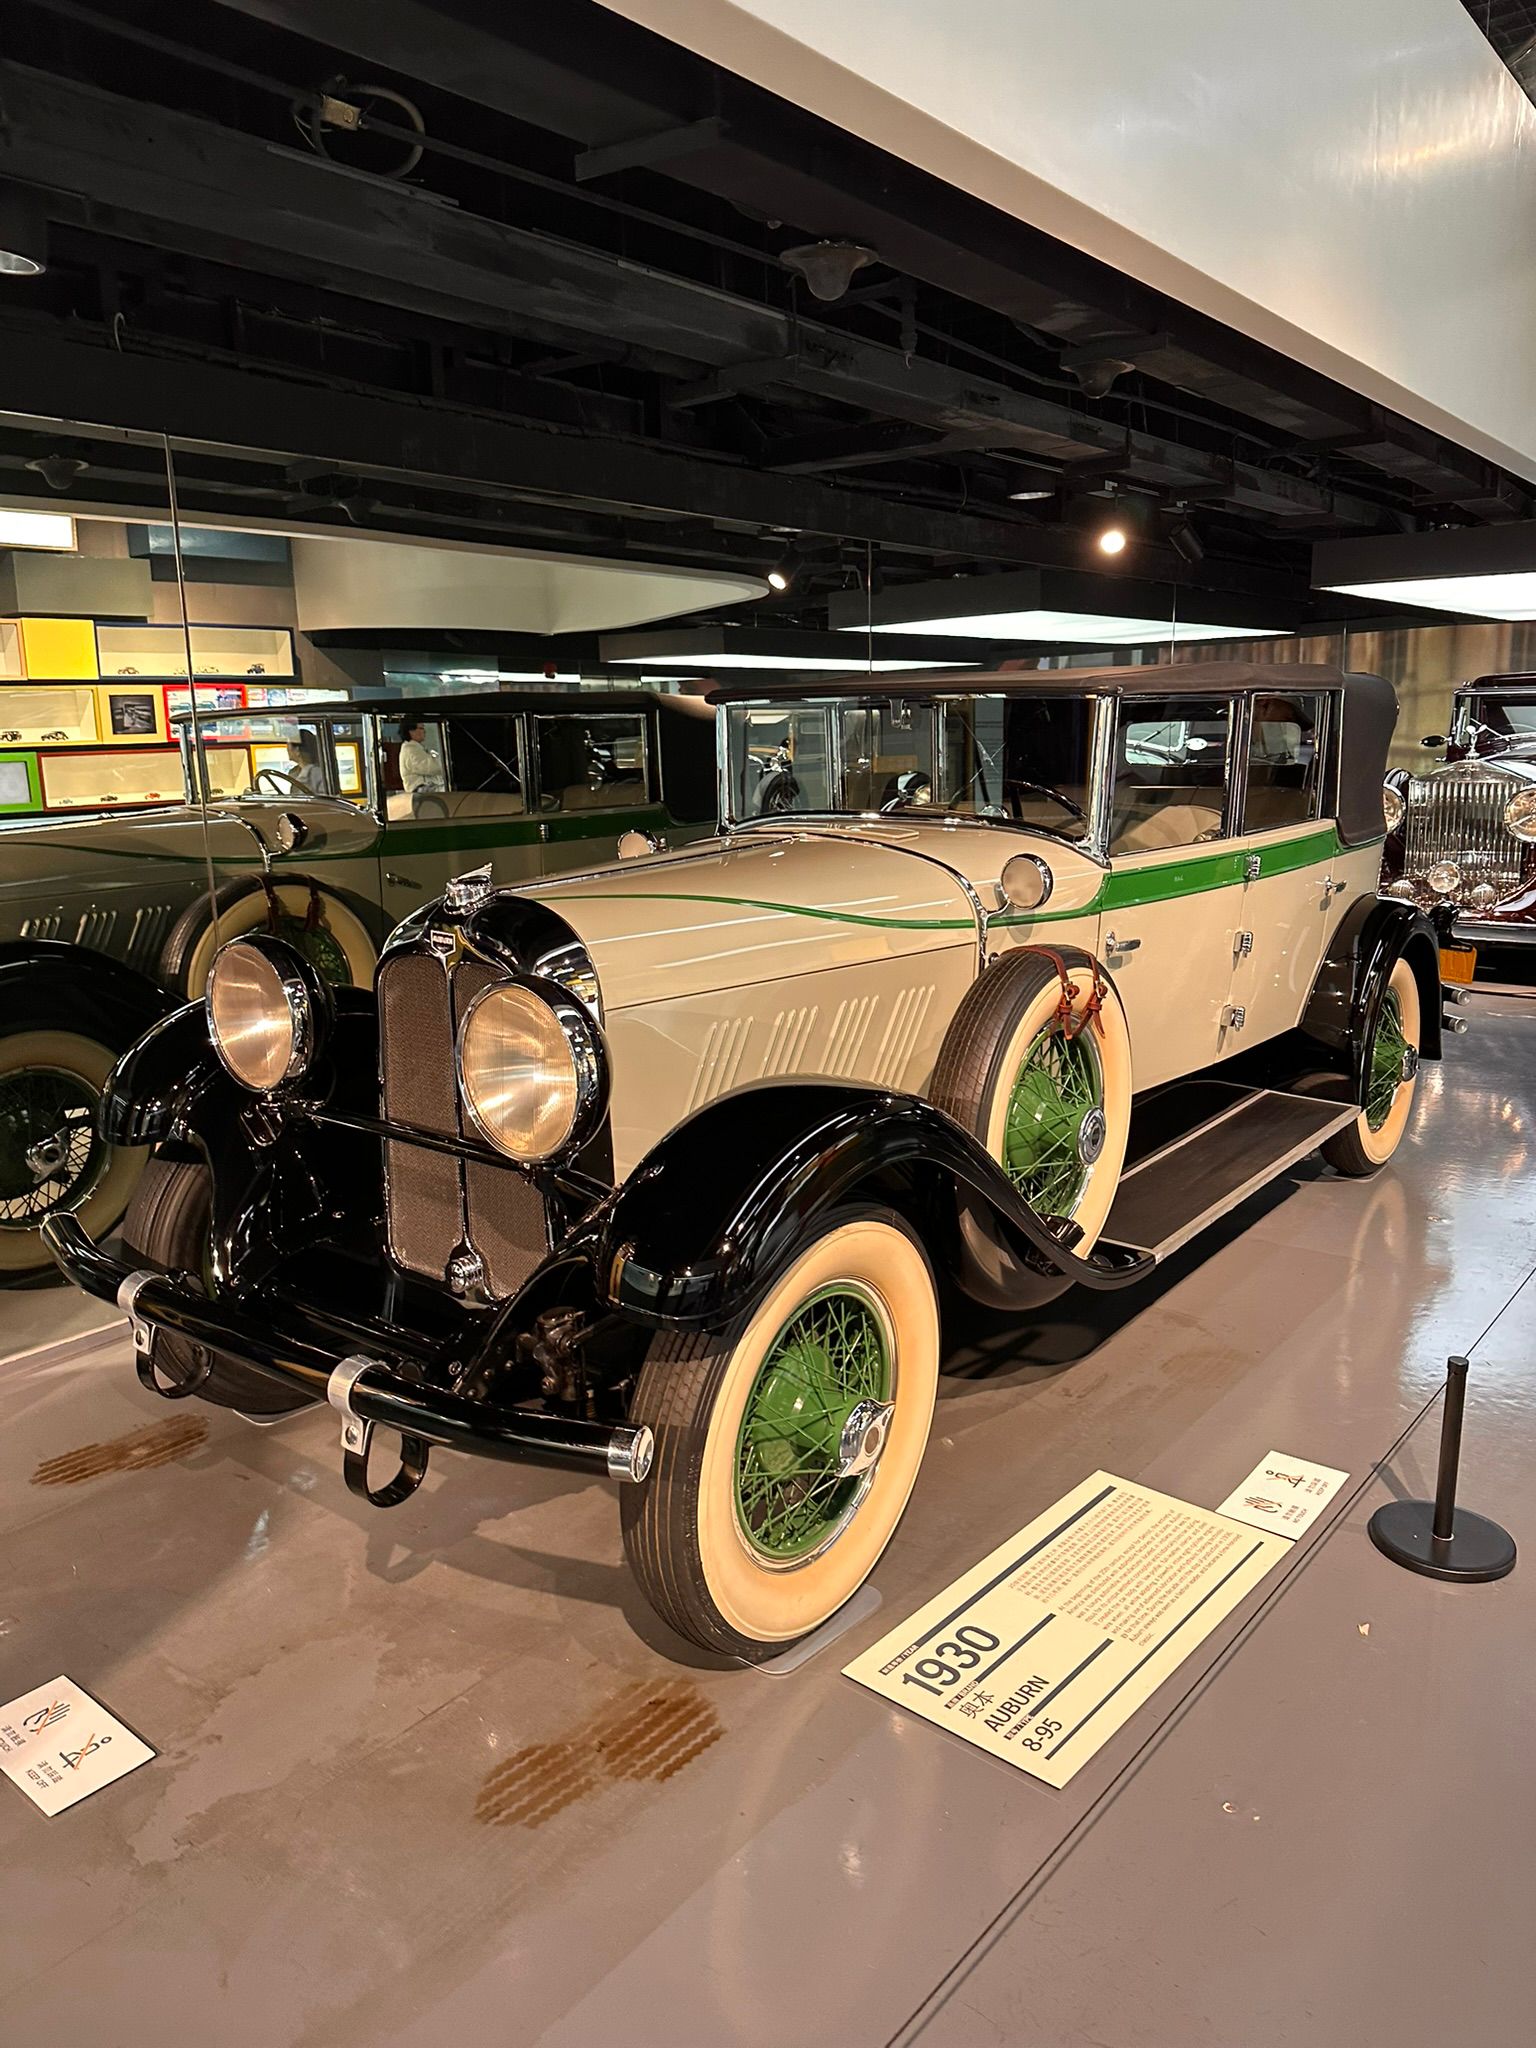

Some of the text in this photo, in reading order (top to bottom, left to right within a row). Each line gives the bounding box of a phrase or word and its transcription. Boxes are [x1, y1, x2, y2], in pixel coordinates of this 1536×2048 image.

[902, 1625, 1000, 1696] 1930
[958, 1690, 994, 1719] 奥本
[983, 1675, 1049, 1732] AUBURN
[1021, 1717, 1062, 1751] 8-95
